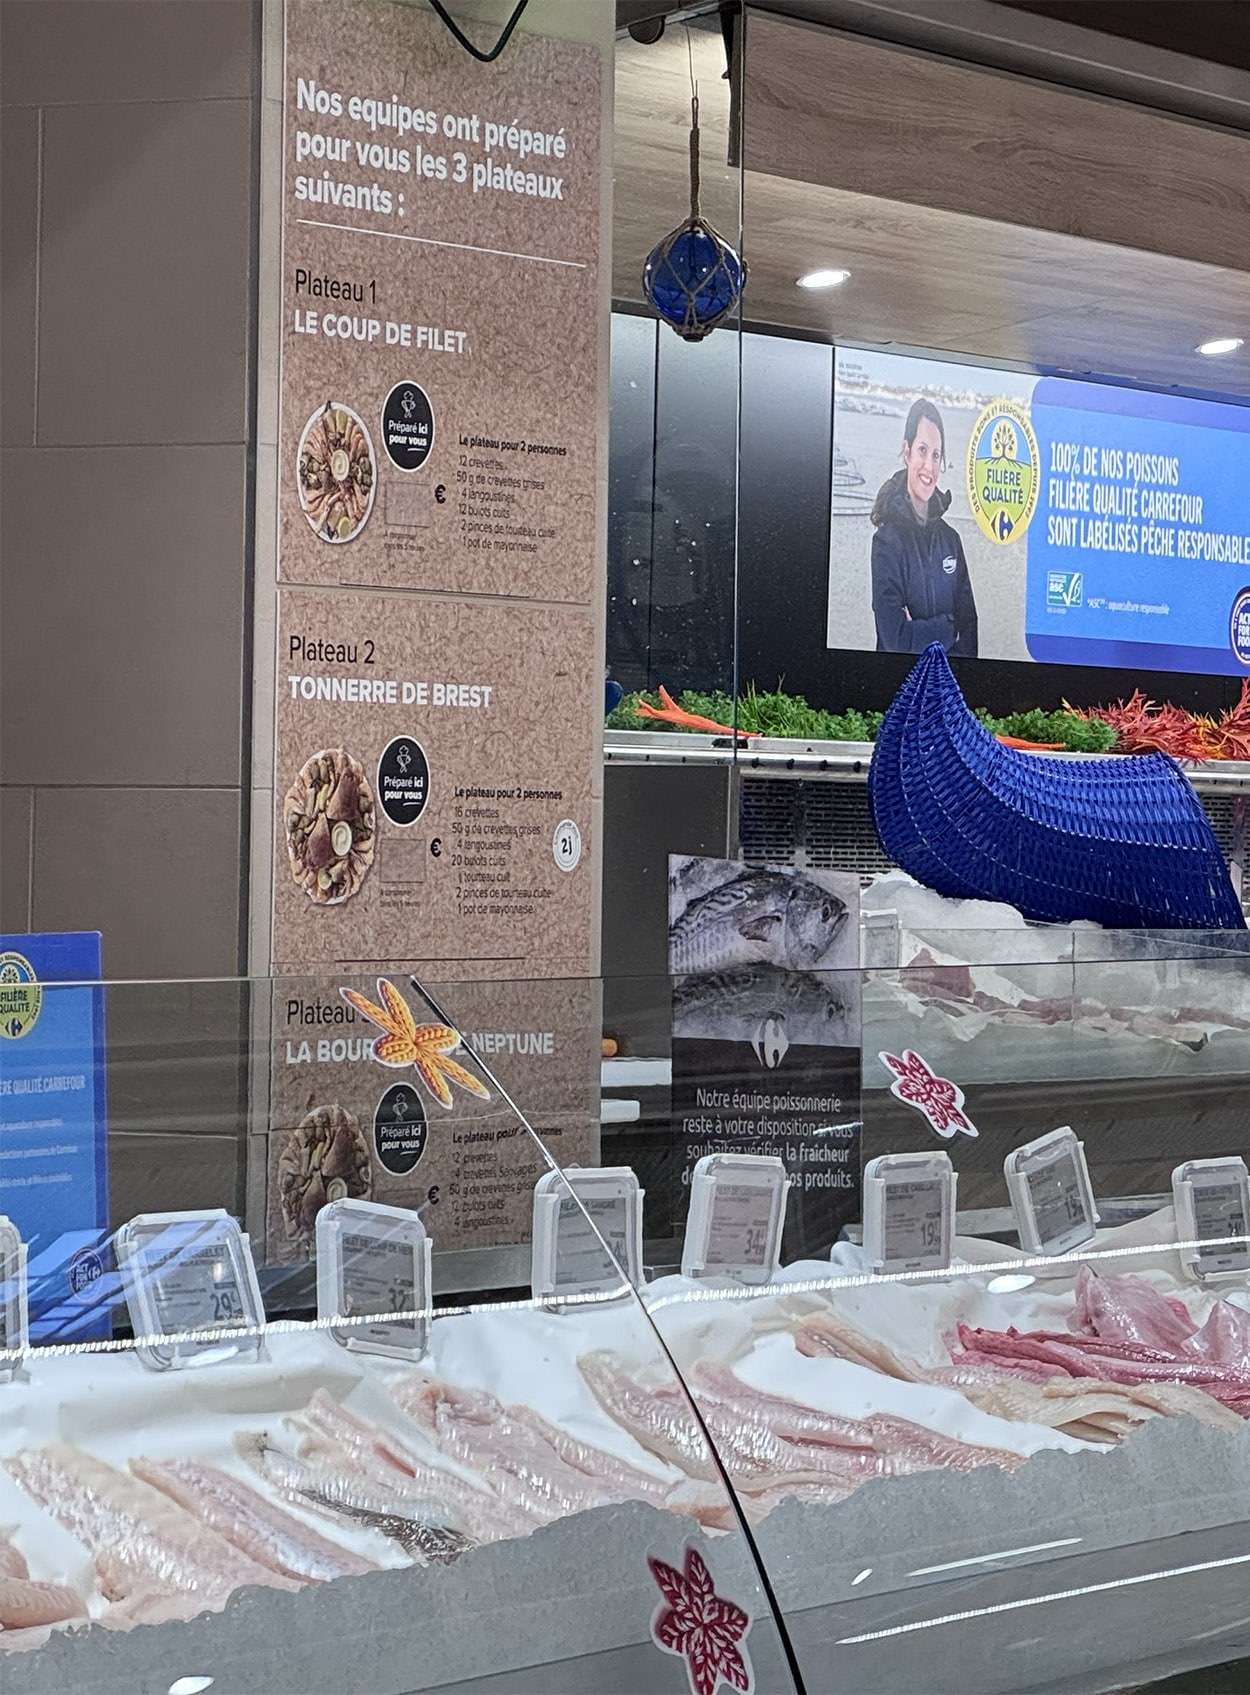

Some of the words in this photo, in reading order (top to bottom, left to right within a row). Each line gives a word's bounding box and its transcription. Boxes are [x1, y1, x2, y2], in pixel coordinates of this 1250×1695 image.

[297, 77, 342, 118] Nos
[349, 94, 437, 136] equipes
[443, 114, 480, 143] ont
[485, 118, 566, 158] préparé
[296, 130, 350, 162] pour
[356, 140, 410, 173] vous
[416, 145, 447, 180] les
[452, 152, 467, 183] 3
[472, 158, 563, 201] plateaux
[295, 170, 392, 214] suivants
[295, 269, 363, 303] Plateau
[369, 280, 376, 304] 1
[294, 309, 318, 335] LE
[322, 314, 380, 342] COUP
[386, 321, 411, 347] DE
[417, 326, 467, 354] FILET
[388, 420, 417, 434] Préparé
[418, 423, 428, 434] ici
[389, 435, 407, 445] pour
[408, 436, 427, 447] vous
[459, 434, 468, 446] Le
[470, 435, 500, 449] plateau
[501, 441, 519, 452] pour
[520, 440, 526, 452] 2
[528, 444, 567, 456] personnes
[1050, 442, 1081, 477] 100%
[1083, 446, 1098, 477] DE
[1101, 448, 1123, 479] NOS
[1126, 451, 1179, 486] POISSONS
[987, 467, 1021, 487] FILIÈRE
[435, 485, 446, 504] €
[983, 485, 1024, 505] QUALITÉ
[1049, 475, 1090, 512] FILIÈRE
[1093, 481, 1139, 517] QUALITÉ
[1141, 489, 1203, 524] CARREFOUR
[1048, 515, 1078, 547] SONT
[1080, 514, 1139, 553] LABÉLISÉS
[1141, 519, 1175, 557] PÊCHE
[1178, 529, 1250, 565] RESPONSABLE
[1239, 612, 1250, 625] ACT
[1238, 625, 1250, 635] FOR
[289, 635, 357, 664] Plateau
[364, 640, 375, 664] 2
[288, 676, 397, 704] TONNERRE
[402, 682, 428, 705] DE
[433, 684, 492, 708] BREST
[384, 776, 413, 790] Préparé
[414, 776, 424, 788] ici
[455, 785, 465, 798] Le
[465, 786, 495, 800] plateau
[497, 789, 514, 800] pour
[516, 787, 521, 799] 2
[523, 790, 563, 800] personnes
[385, 790, 403, 801] pour
[404, 790, 422, 800] vous
[287, 997, 355, 1025] Plateau
[286, 1041, 311, 1064] LA
[472, 1032, 553, 1054] NEPTUNE
[13, 1075, 42, 1095] QUALITÉ
[43, 1074, 85, 1094] CARREFOUR
[697, 1088, 730, 1108] Notre
[733, 1089, 771, 1112] équipe
[773, 1091, 842, 1114] poissonnerie
[381, 1125, 410, 1139] Préparé
[453, 1132, 462, 1144] Le
[464, 1131, 495, 1146] plateau
[496, 1126, 520, 1142] pour
[683, 1115, 713, 1133] reste
[715, 1114, 722, 1135] à
[725, 1116, 755, 1136] votre
[756, 1115, 815, 1139] disposition
[382, 1141, 400, 1152] pour
[401, 1140, 419, 1149] vous
[786, 1142, 797, 1161] la
[800, 1142, 850, 1164] fraîcheur
[805, 1170, 855, 1191] produits.
